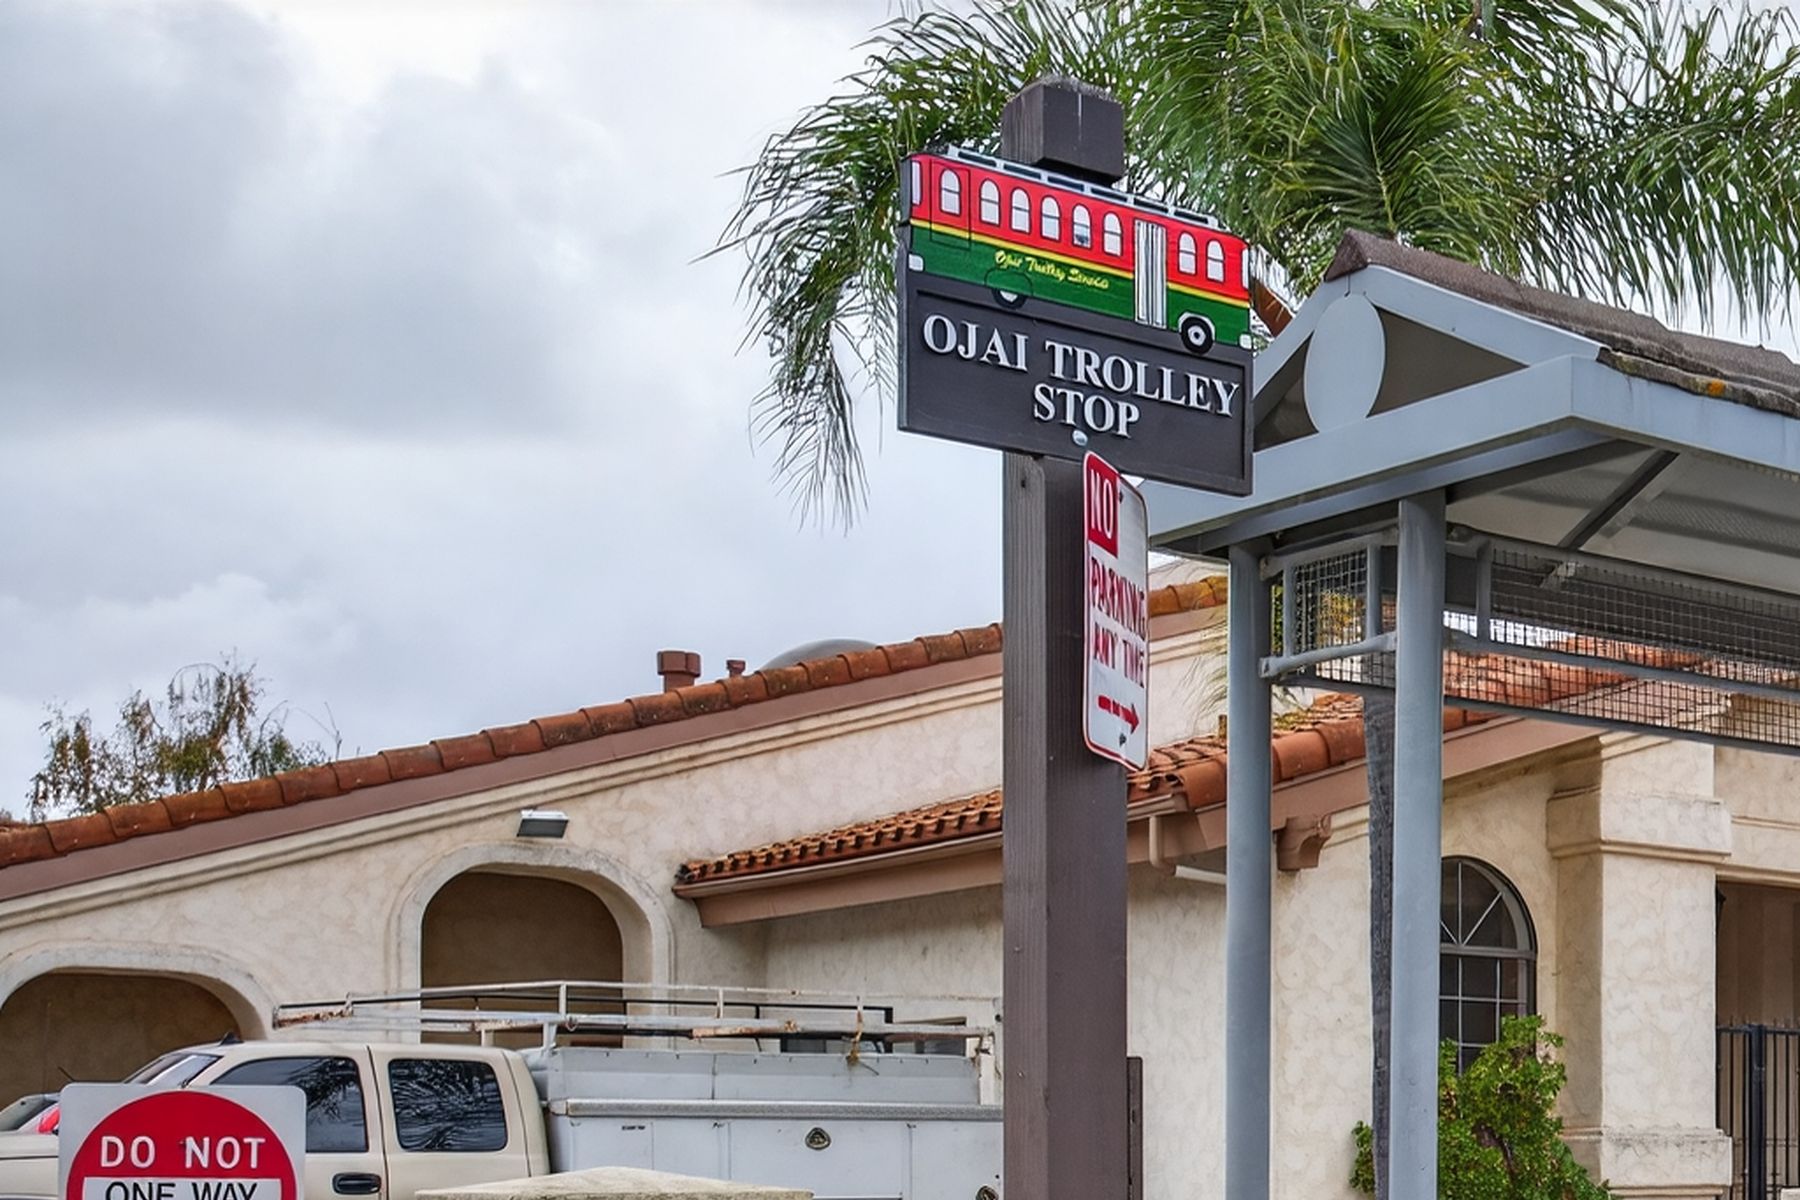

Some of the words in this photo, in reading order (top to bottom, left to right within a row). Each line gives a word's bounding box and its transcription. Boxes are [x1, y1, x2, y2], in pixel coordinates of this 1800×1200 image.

[923, 314, 1029, 371] OJAI
[1045, 340, 1240, 418] TROLLEY
[1033, 382, 1140, 440] STOP
[1090, 468, 1114, 540] NO
[101, 1135, 156, 1168] DO
[185, 1136, 266, 1169] NOT
